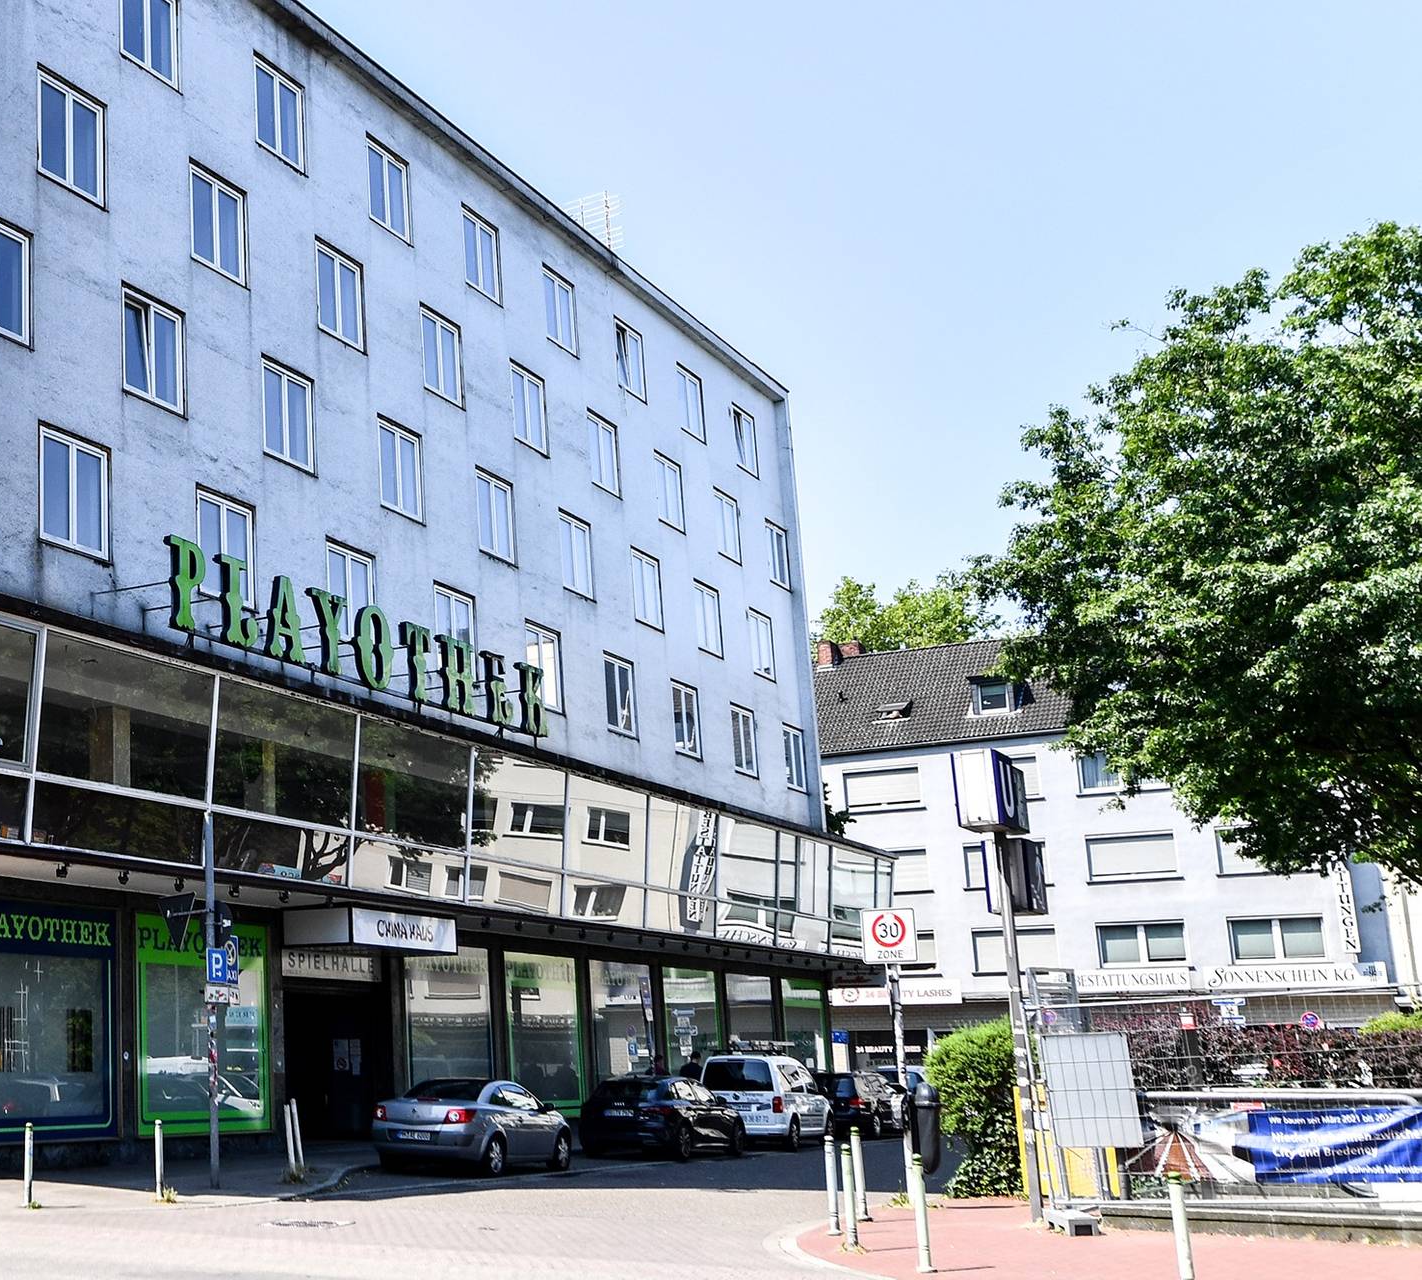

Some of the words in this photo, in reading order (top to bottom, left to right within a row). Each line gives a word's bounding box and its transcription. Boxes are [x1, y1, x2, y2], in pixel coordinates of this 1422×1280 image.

[163, 534, 548, 738] PLAYOTHEK
[998, 760, 1015, 818] U
[1334, 861, 1356, 950] ATTUNGEN
[376, 919, 407, 941] CHINA
[409, 923, 434, 943] HAUS
[878, 922, 899, 939] 30
[212, 952, 223, 978] P
[288, 952, 374, 974] SPIELHALLE
[877, 949, 904, 959] ZONE
[226, 970, 237, 980] AXI
[1208, 967, 1329, 988] SONNENSCHEIN
[1333, 967, 1355, 982] KG
[917, 989, 953, 998] LASHES
